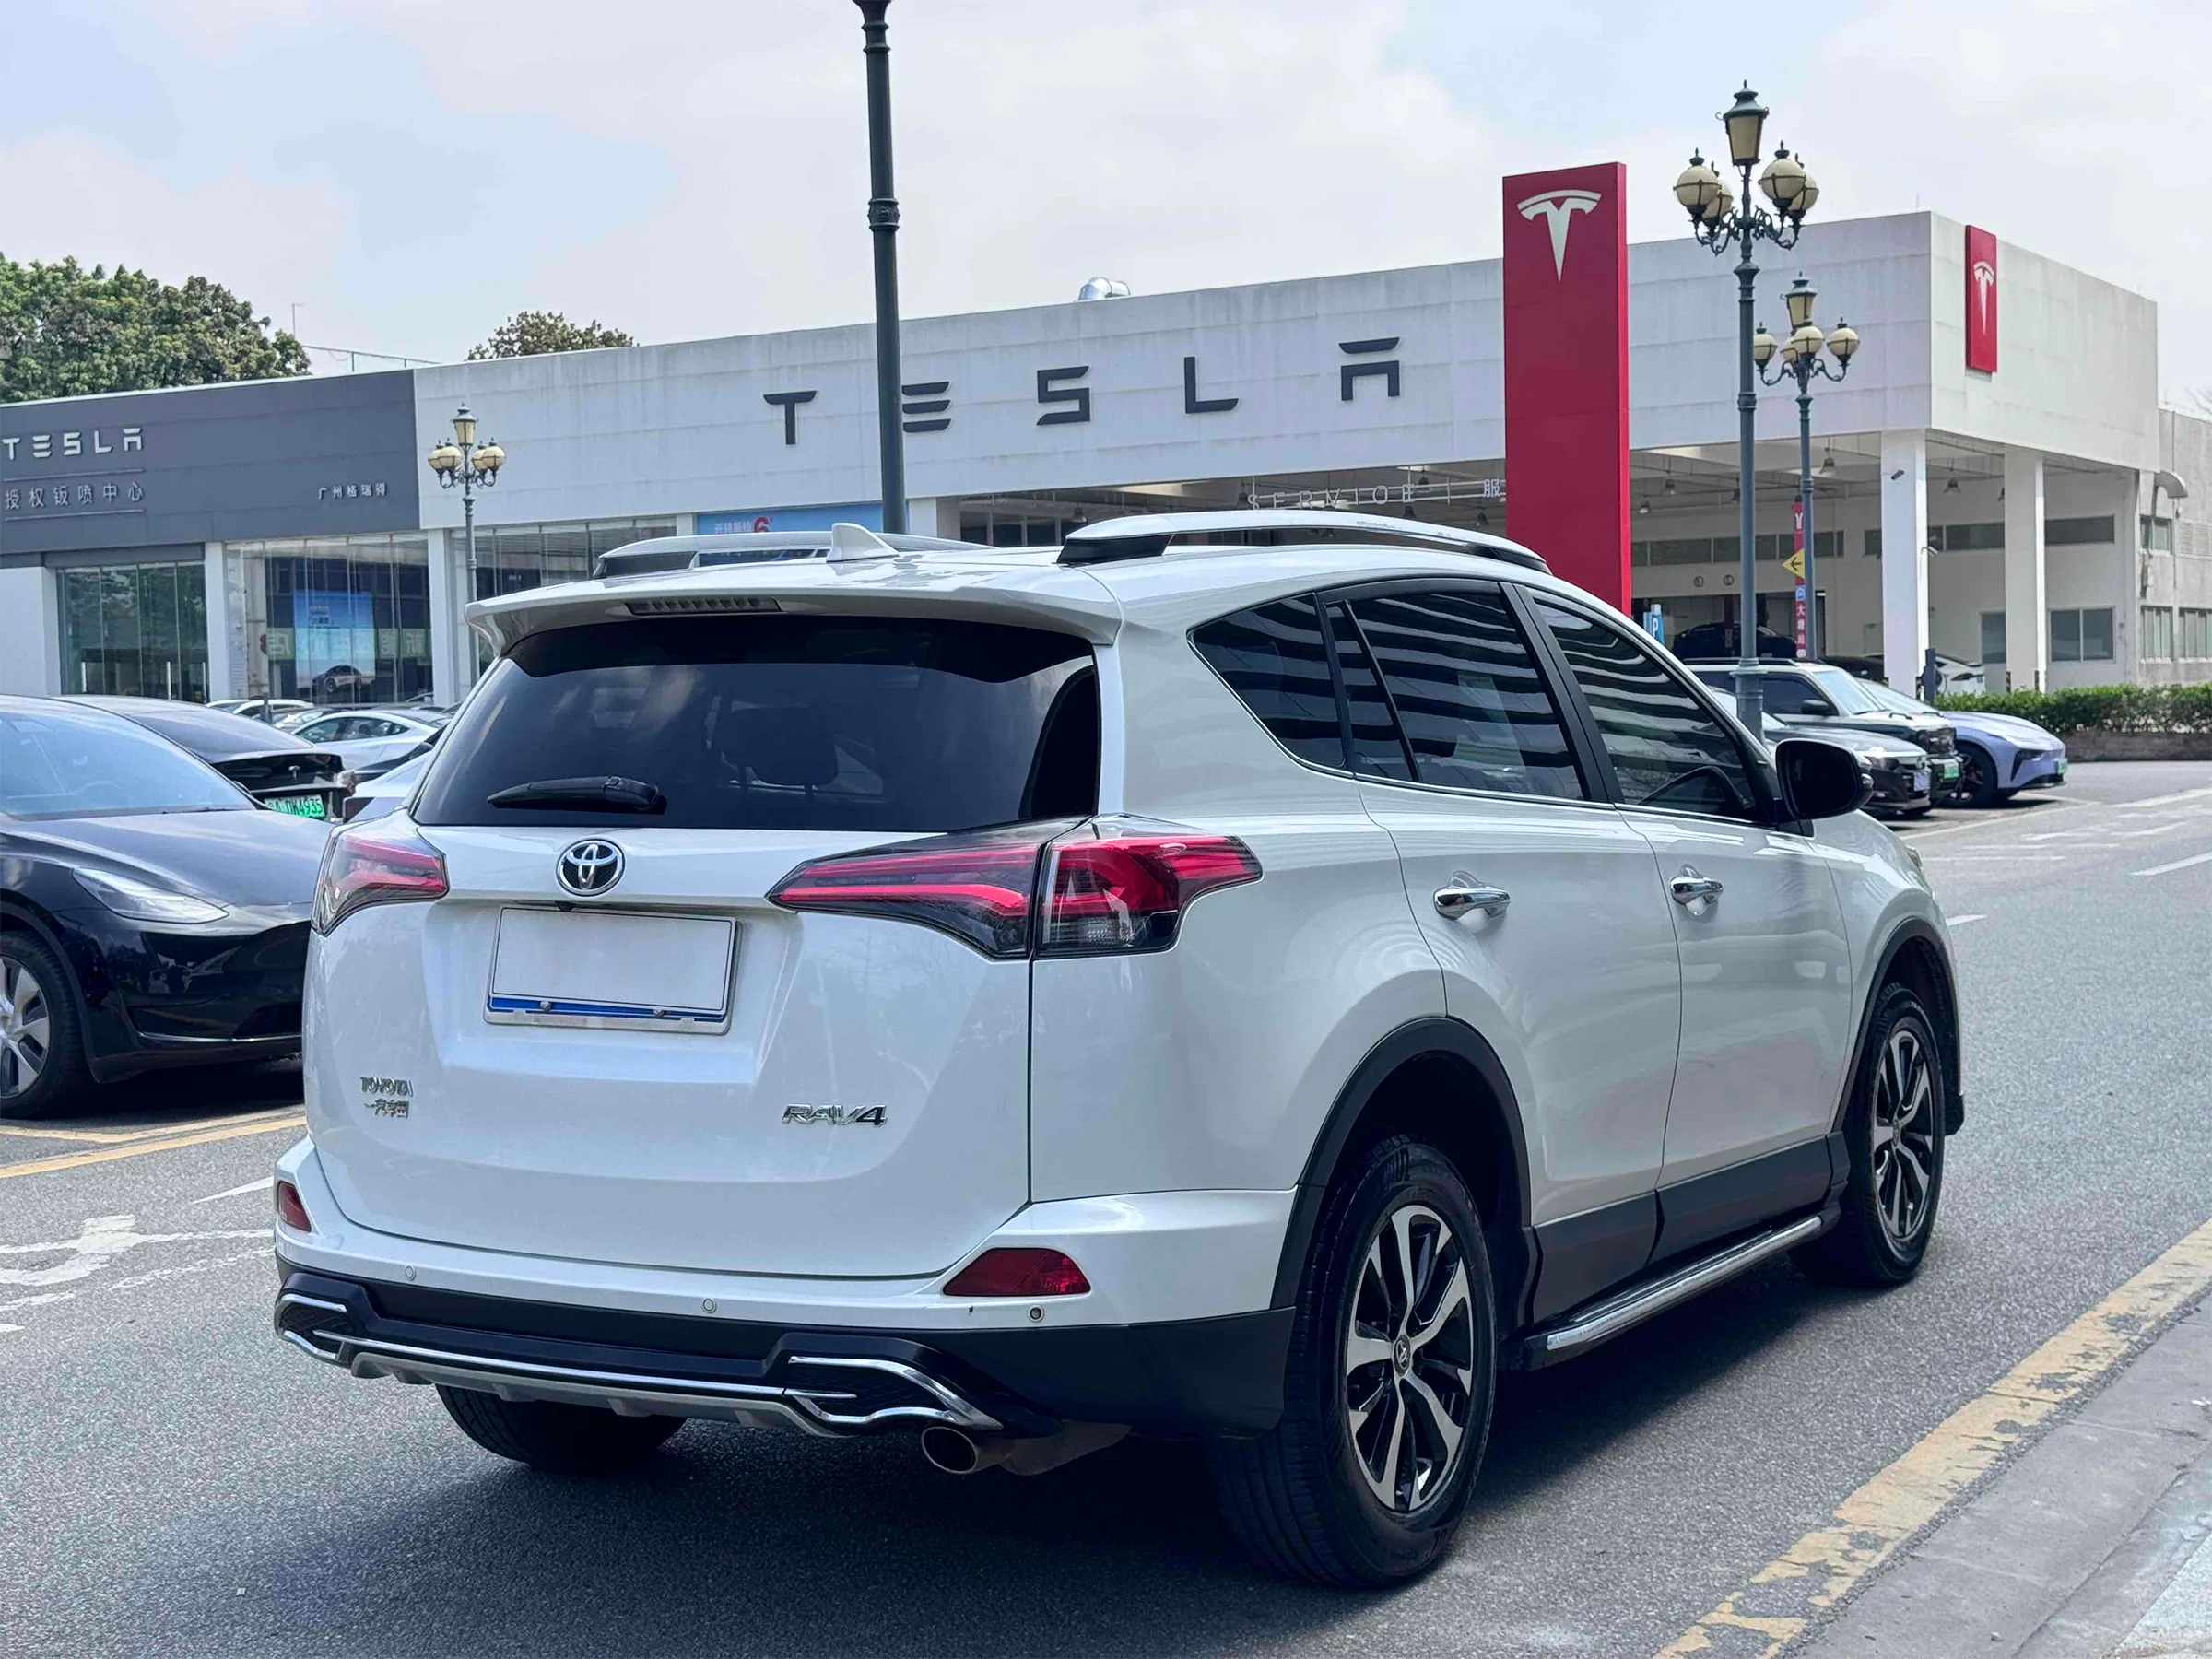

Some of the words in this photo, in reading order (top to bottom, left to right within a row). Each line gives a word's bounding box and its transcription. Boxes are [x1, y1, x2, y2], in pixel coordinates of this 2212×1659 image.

[763, 336, 1401, 446] TESLA
[2, 427, 144, 461] TESLA
[6, 482, 144, 511] 授权钣喷中心
[360, 1077, 414, 1097] TOYOTA
[782, 1103, 888, 1126] RAV4
